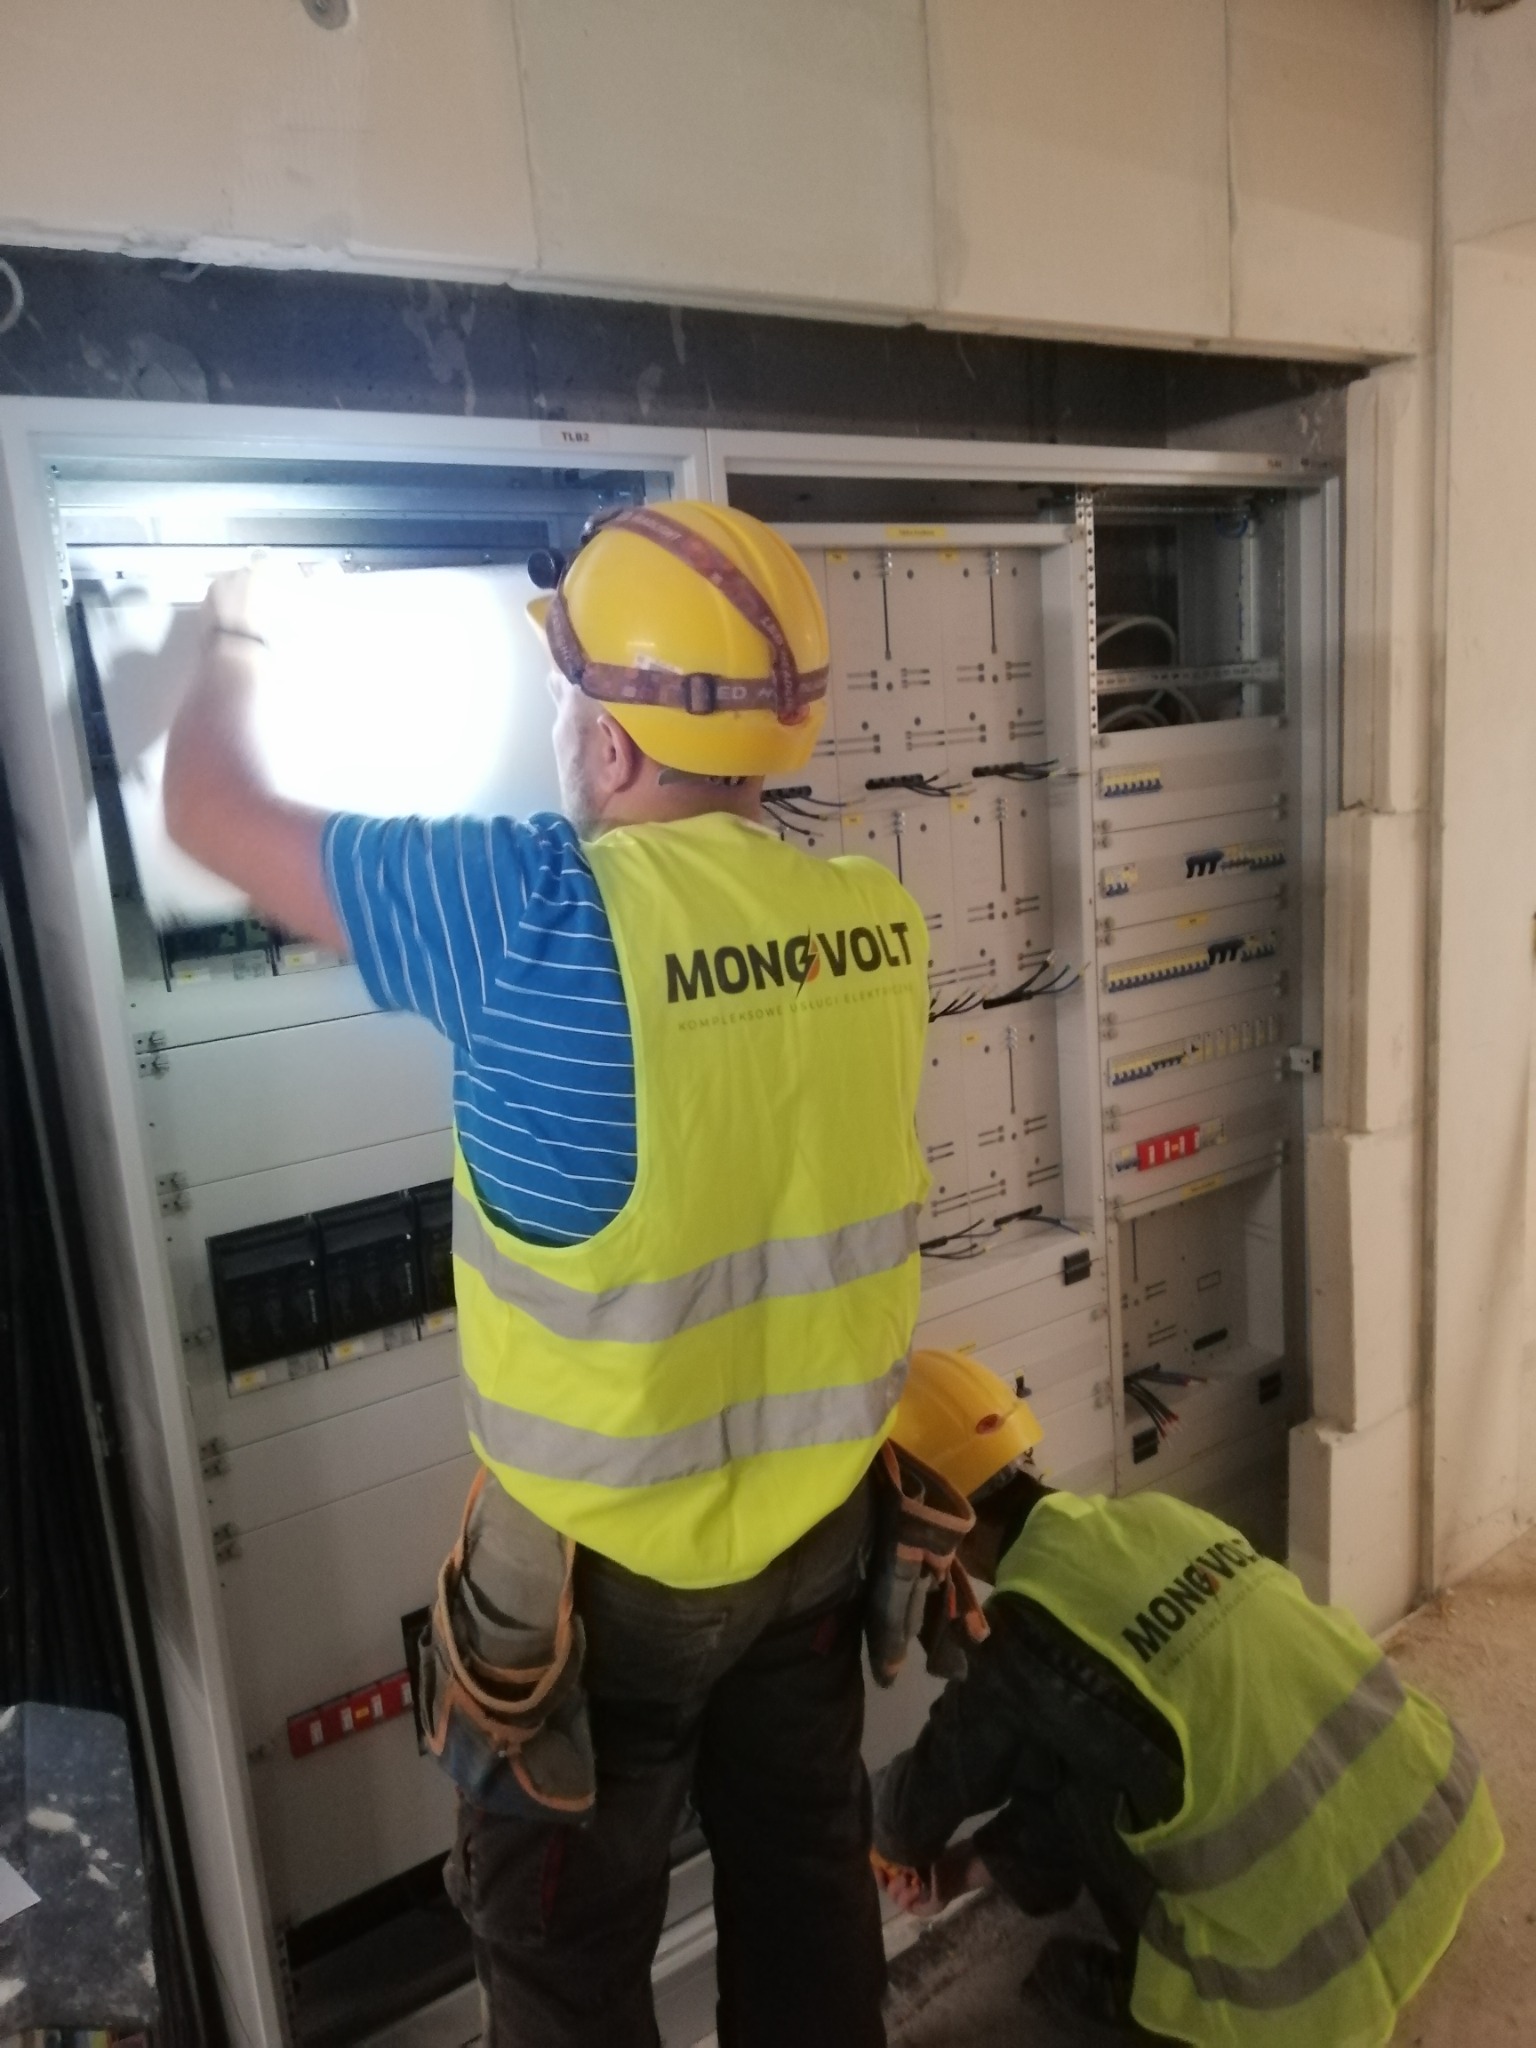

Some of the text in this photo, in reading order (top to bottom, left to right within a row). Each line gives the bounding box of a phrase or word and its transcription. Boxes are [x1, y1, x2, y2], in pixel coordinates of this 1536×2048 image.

[716, 685, 748, 701] ED
[665, 922, 912, 1003] MONOVOLT
[678, 1005, 783, 1031] KOMPLEKSOWE
[1121, 1537, 1258, 1665] MONOVO
